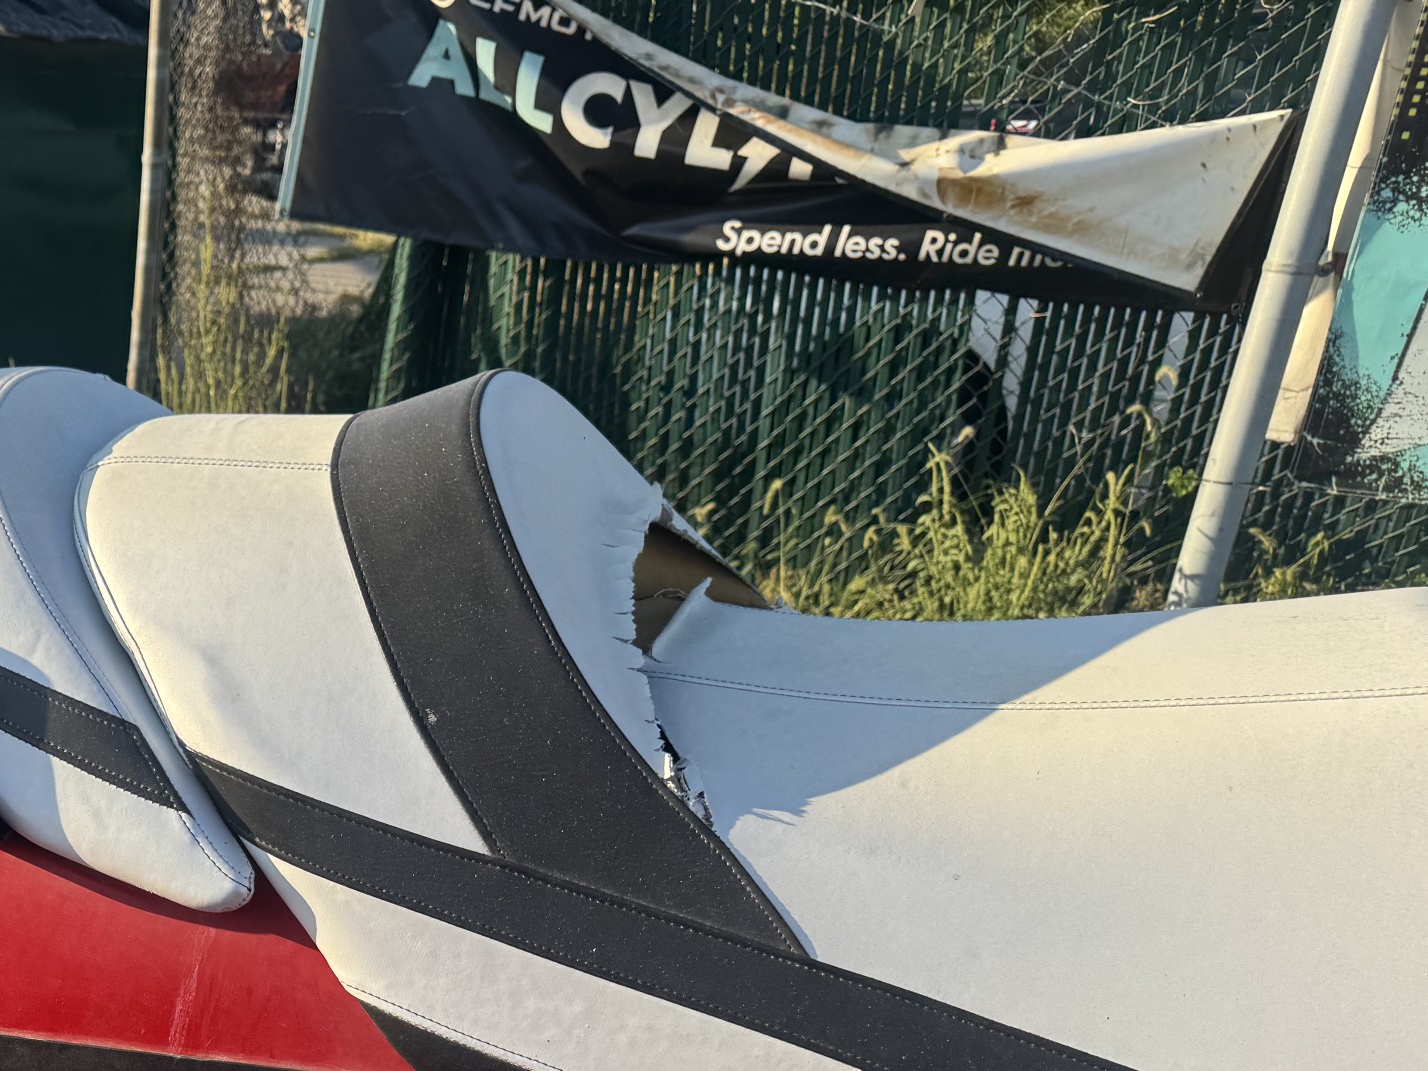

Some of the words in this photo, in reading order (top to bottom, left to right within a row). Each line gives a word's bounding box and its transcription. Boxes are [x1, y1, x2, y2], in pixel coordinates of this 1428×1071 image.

[716, 219, 832, 258] Spend
[834, 224, 907, 262] less.
[918, 229, 999, 265] Ride
